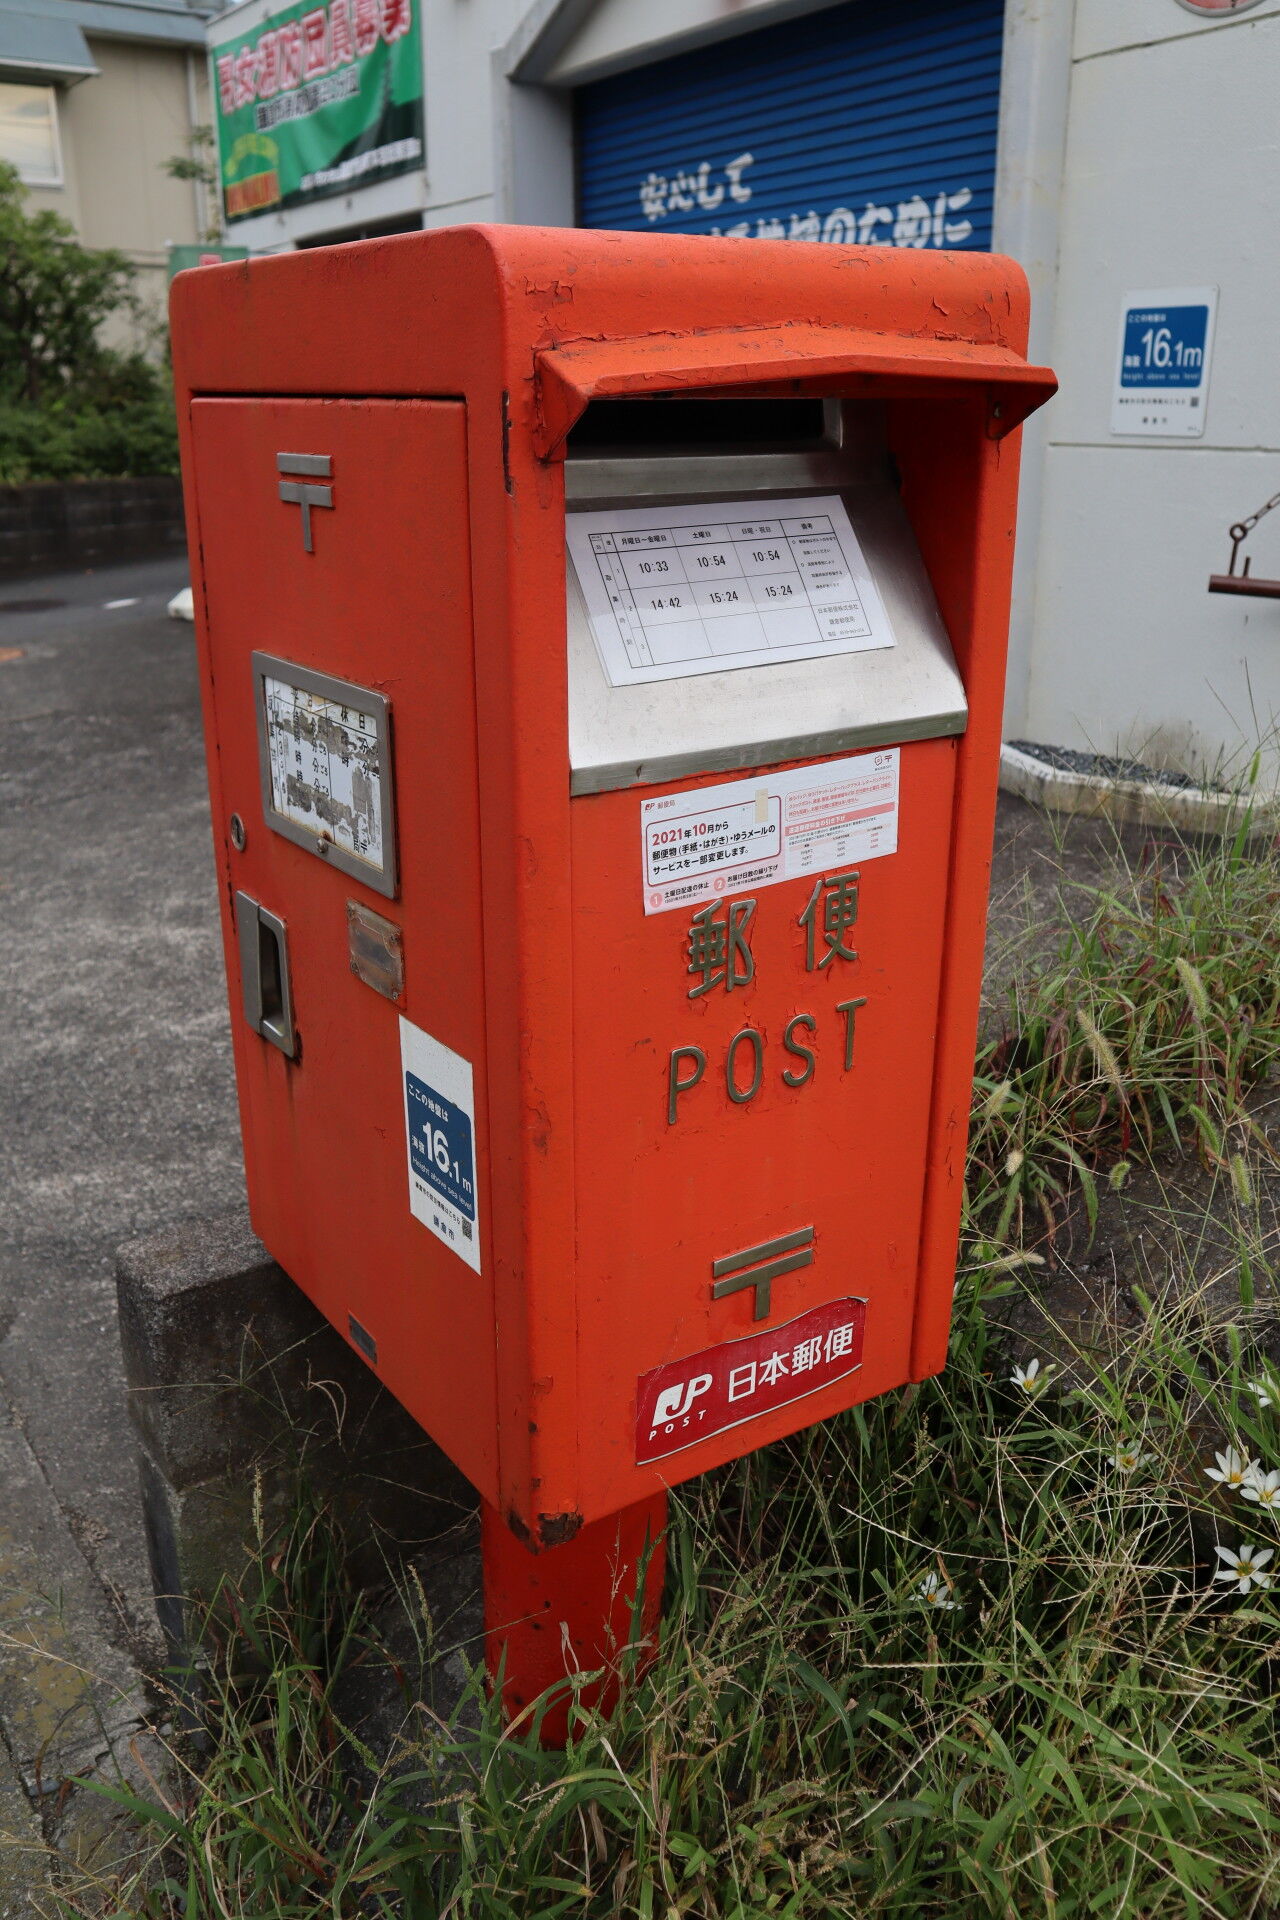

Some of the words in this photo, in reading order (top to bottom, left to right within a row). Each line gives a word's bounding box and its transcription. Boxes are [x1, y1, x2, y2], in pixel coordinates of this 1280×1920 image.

[640, 152, 754, 223] 安心して
[1141, 327, 1203, 367] 16.1m
[692, 531, 712, 540] 土曜日
[740, 526, 772, 536] 日曜・祝日
[638, 560, 669, 574] 10:33
[696, 555, 726, 568] 10:54
[752, 550, 781, 562] 10:54
[651, 597, 682, 611] 14:42
[709, 591, 739, 603] 15:24
[765, 584, 793, 597] 15:24
[341, 704, 366, 730] 休日
[656, 799, 676, 810] 郵便局
[652, 821, 729, 847] 2021年10月から
[653, 845, 749, 876] サービスを一部変更します。
[664, 881, 710, 899] 土曜日配達の休止
[688, 871, 861, 999] 郵便
[668, 997, 868, 1125] POST
[408, 1083, 449, 1122] ここの地盤は
[412, 1155, 430, 1177] Height
[430, 1173, 447, 1191] above
[447, 1186, 458, 1200] sea
[458, 1194, 473, 1212] level
[433, 1214, 455, 1242] 鎌倉市
[727, 1322, 855, 1404] 日本郵便
[648, 1409, 708, 1441] POST
